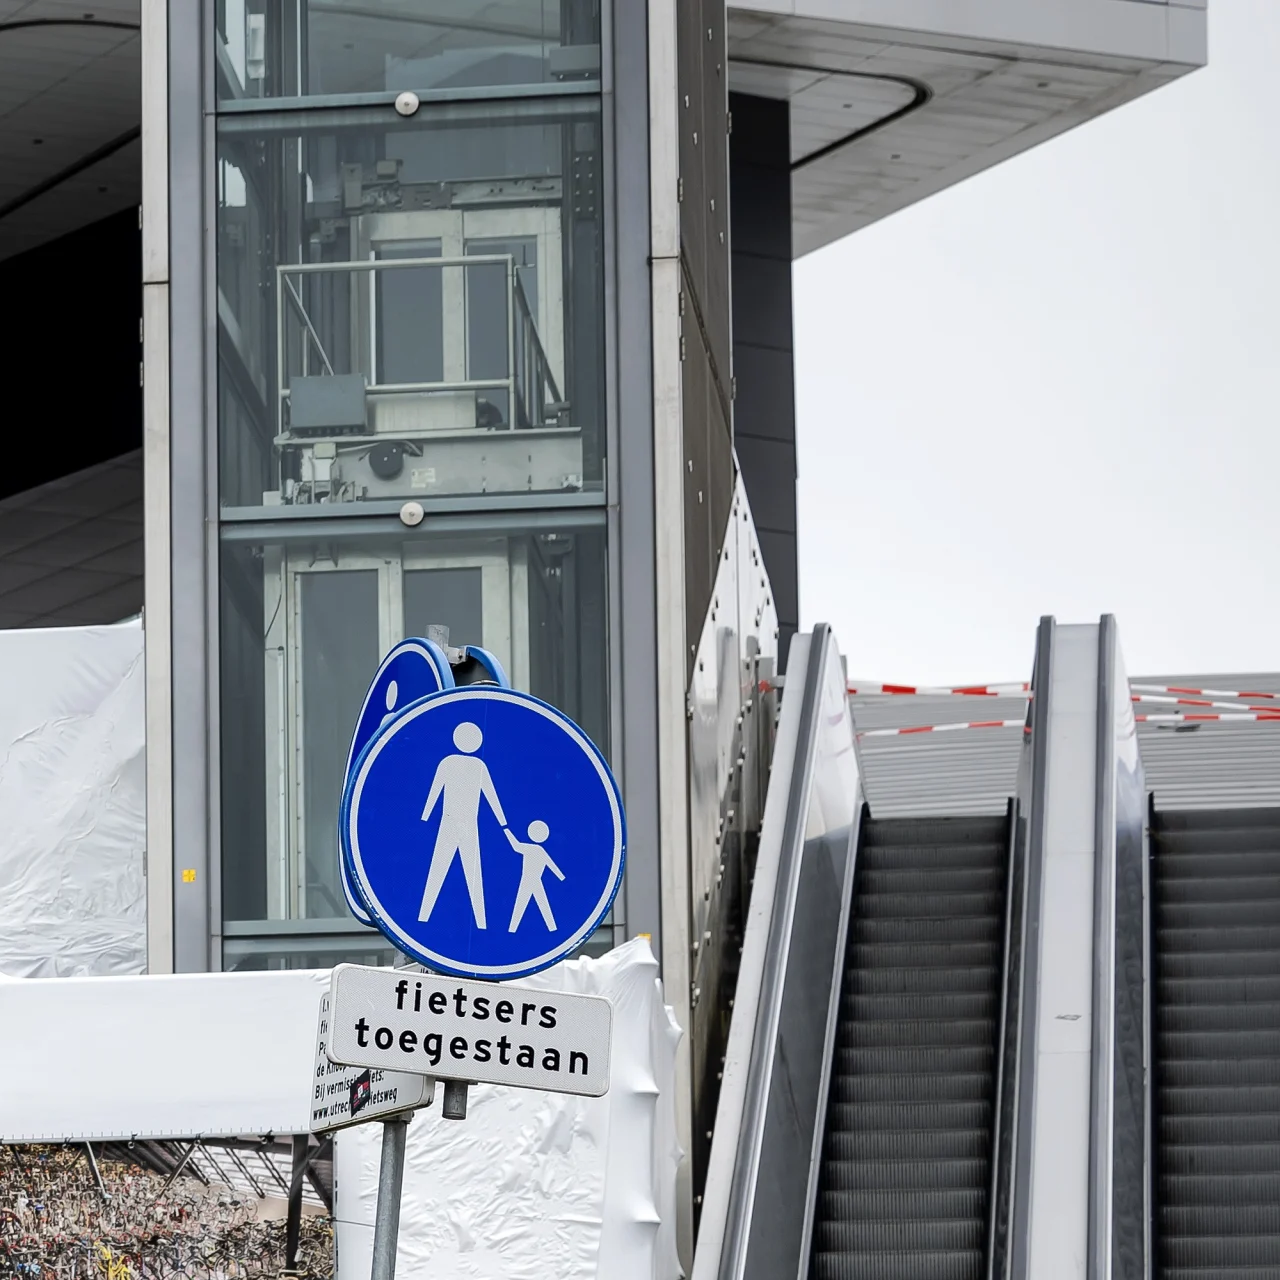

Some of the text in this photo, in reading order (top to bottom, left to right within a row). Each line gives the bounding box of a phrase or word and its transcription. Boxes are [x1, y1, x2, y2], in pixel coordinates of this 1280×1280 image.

[395, 980, 557, 1028] fietsers
[355, 1018, 589, 1075] toegestaan
[315, 1085, 325, 1102] Bij
